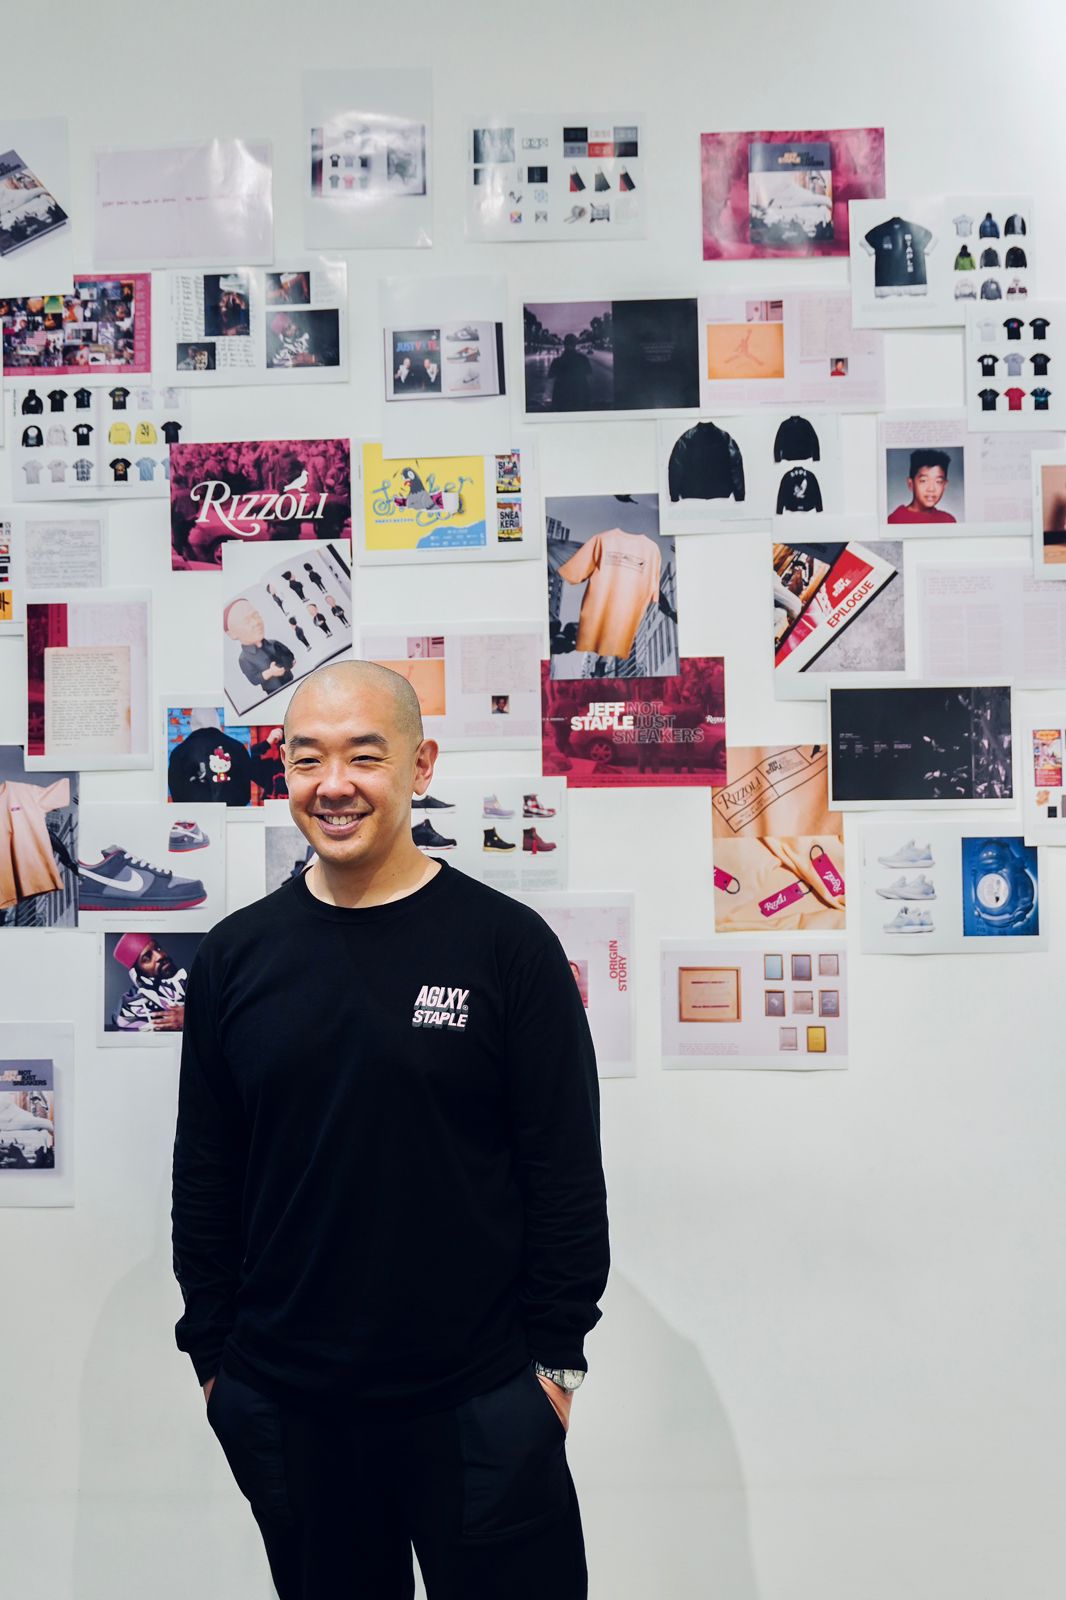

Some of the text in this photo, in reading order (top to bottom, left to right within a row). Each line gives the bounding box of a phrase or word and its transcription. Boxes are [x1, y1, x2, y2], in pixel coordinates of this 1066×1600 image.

[190, 480, 329, 537] RIZZOLI
[826, 580, 874, 628] EPILOGUE
[570, 714, 677, 731] STAPLE JUST
[586, 701, 664, 717] JEFF NOT
[612, 728, 705, 744] SNEAKERS
[718, 776, 762, 810] RIZZOLI
[609, 940, 618, 979] ORIGIN
[617, 955, 628, 992] STORY
[413, 985, 470, 1011] AGLXY
[412, 1009, 469, 1030] STAPLE
